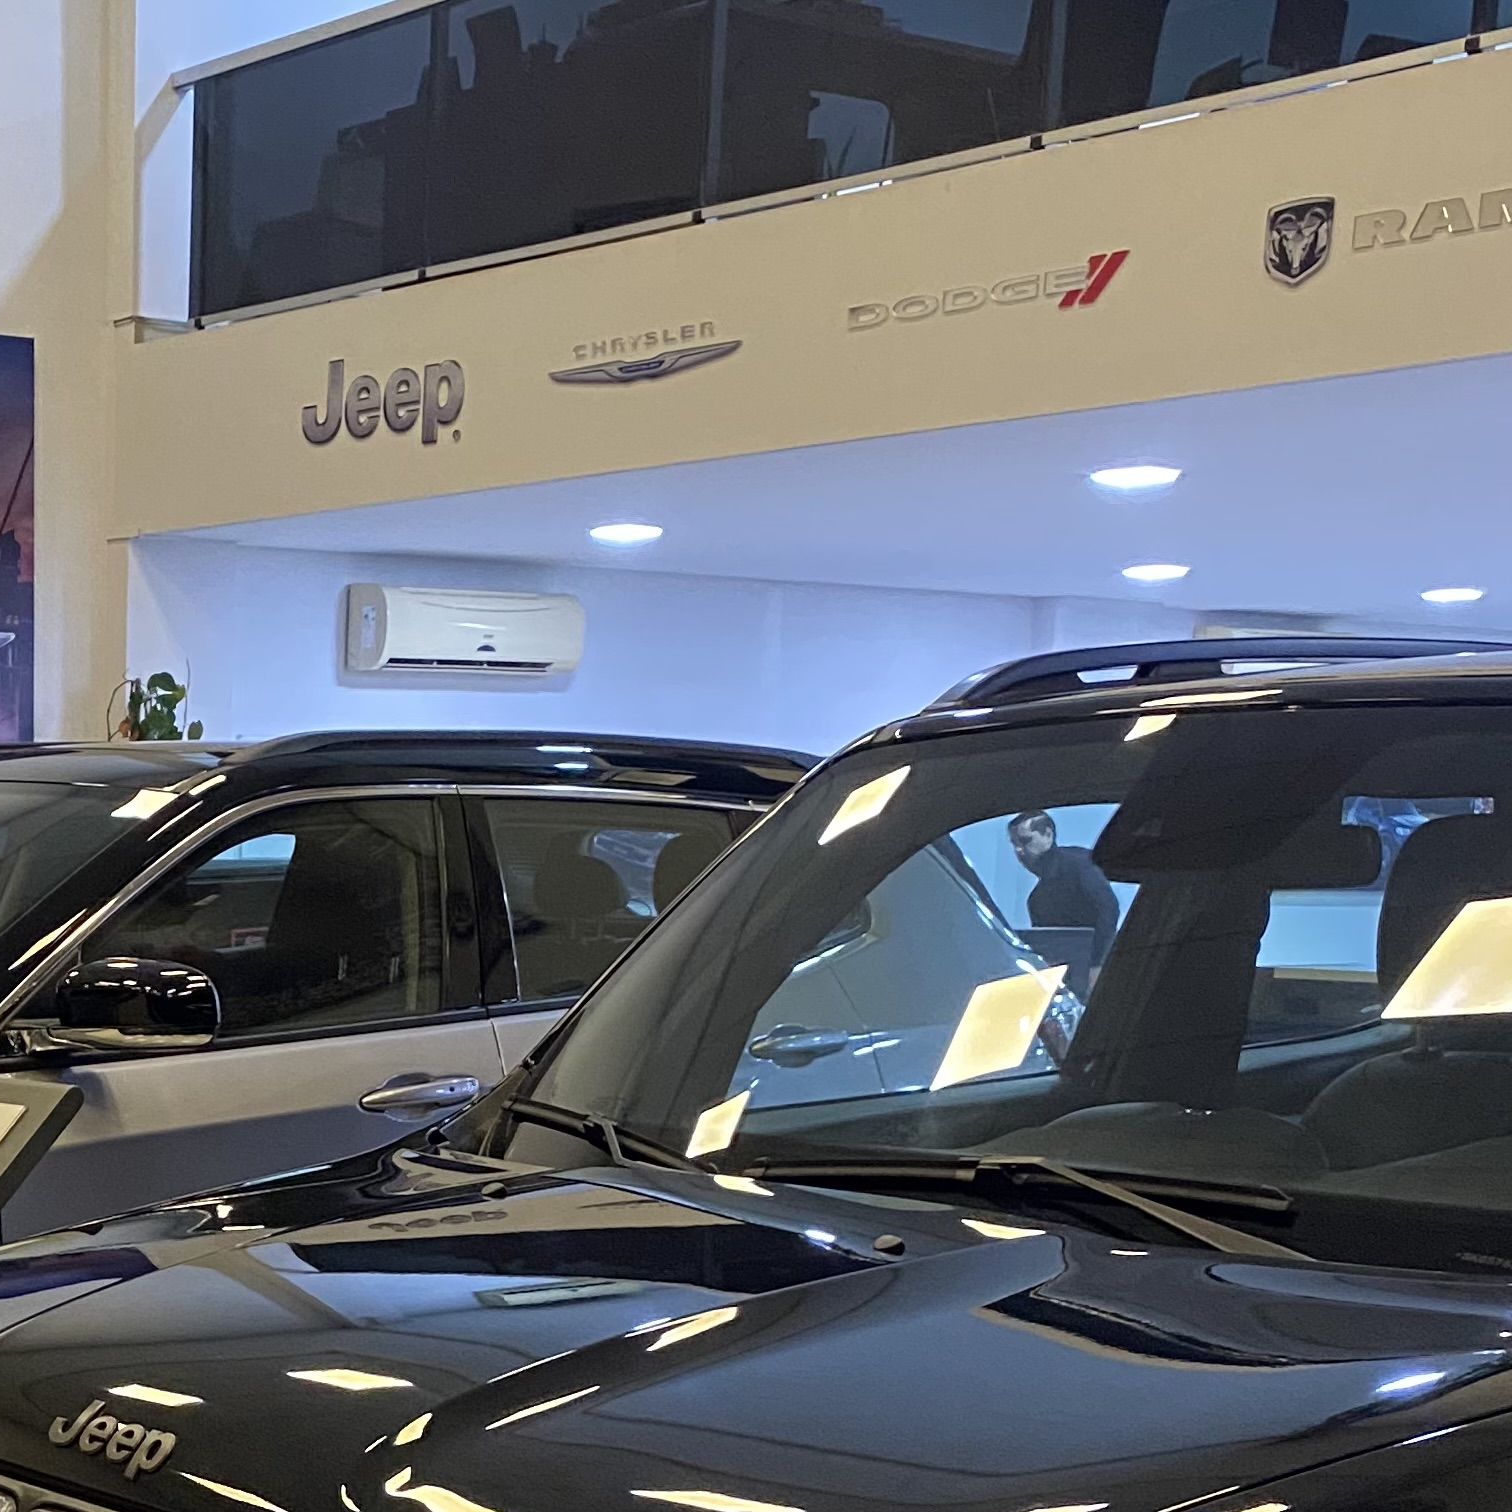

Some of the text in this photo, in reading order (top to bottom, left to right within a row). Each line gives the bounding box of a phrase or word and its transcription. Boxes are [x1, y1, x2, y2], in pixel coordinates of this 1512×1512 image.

[847, 263, 1089, 333] DODGE
[571, 320, 717, 361] CHRYSLER
[301, 358, 466, 445] Jeep
[47, 1399, 177, 1481] Jeep
